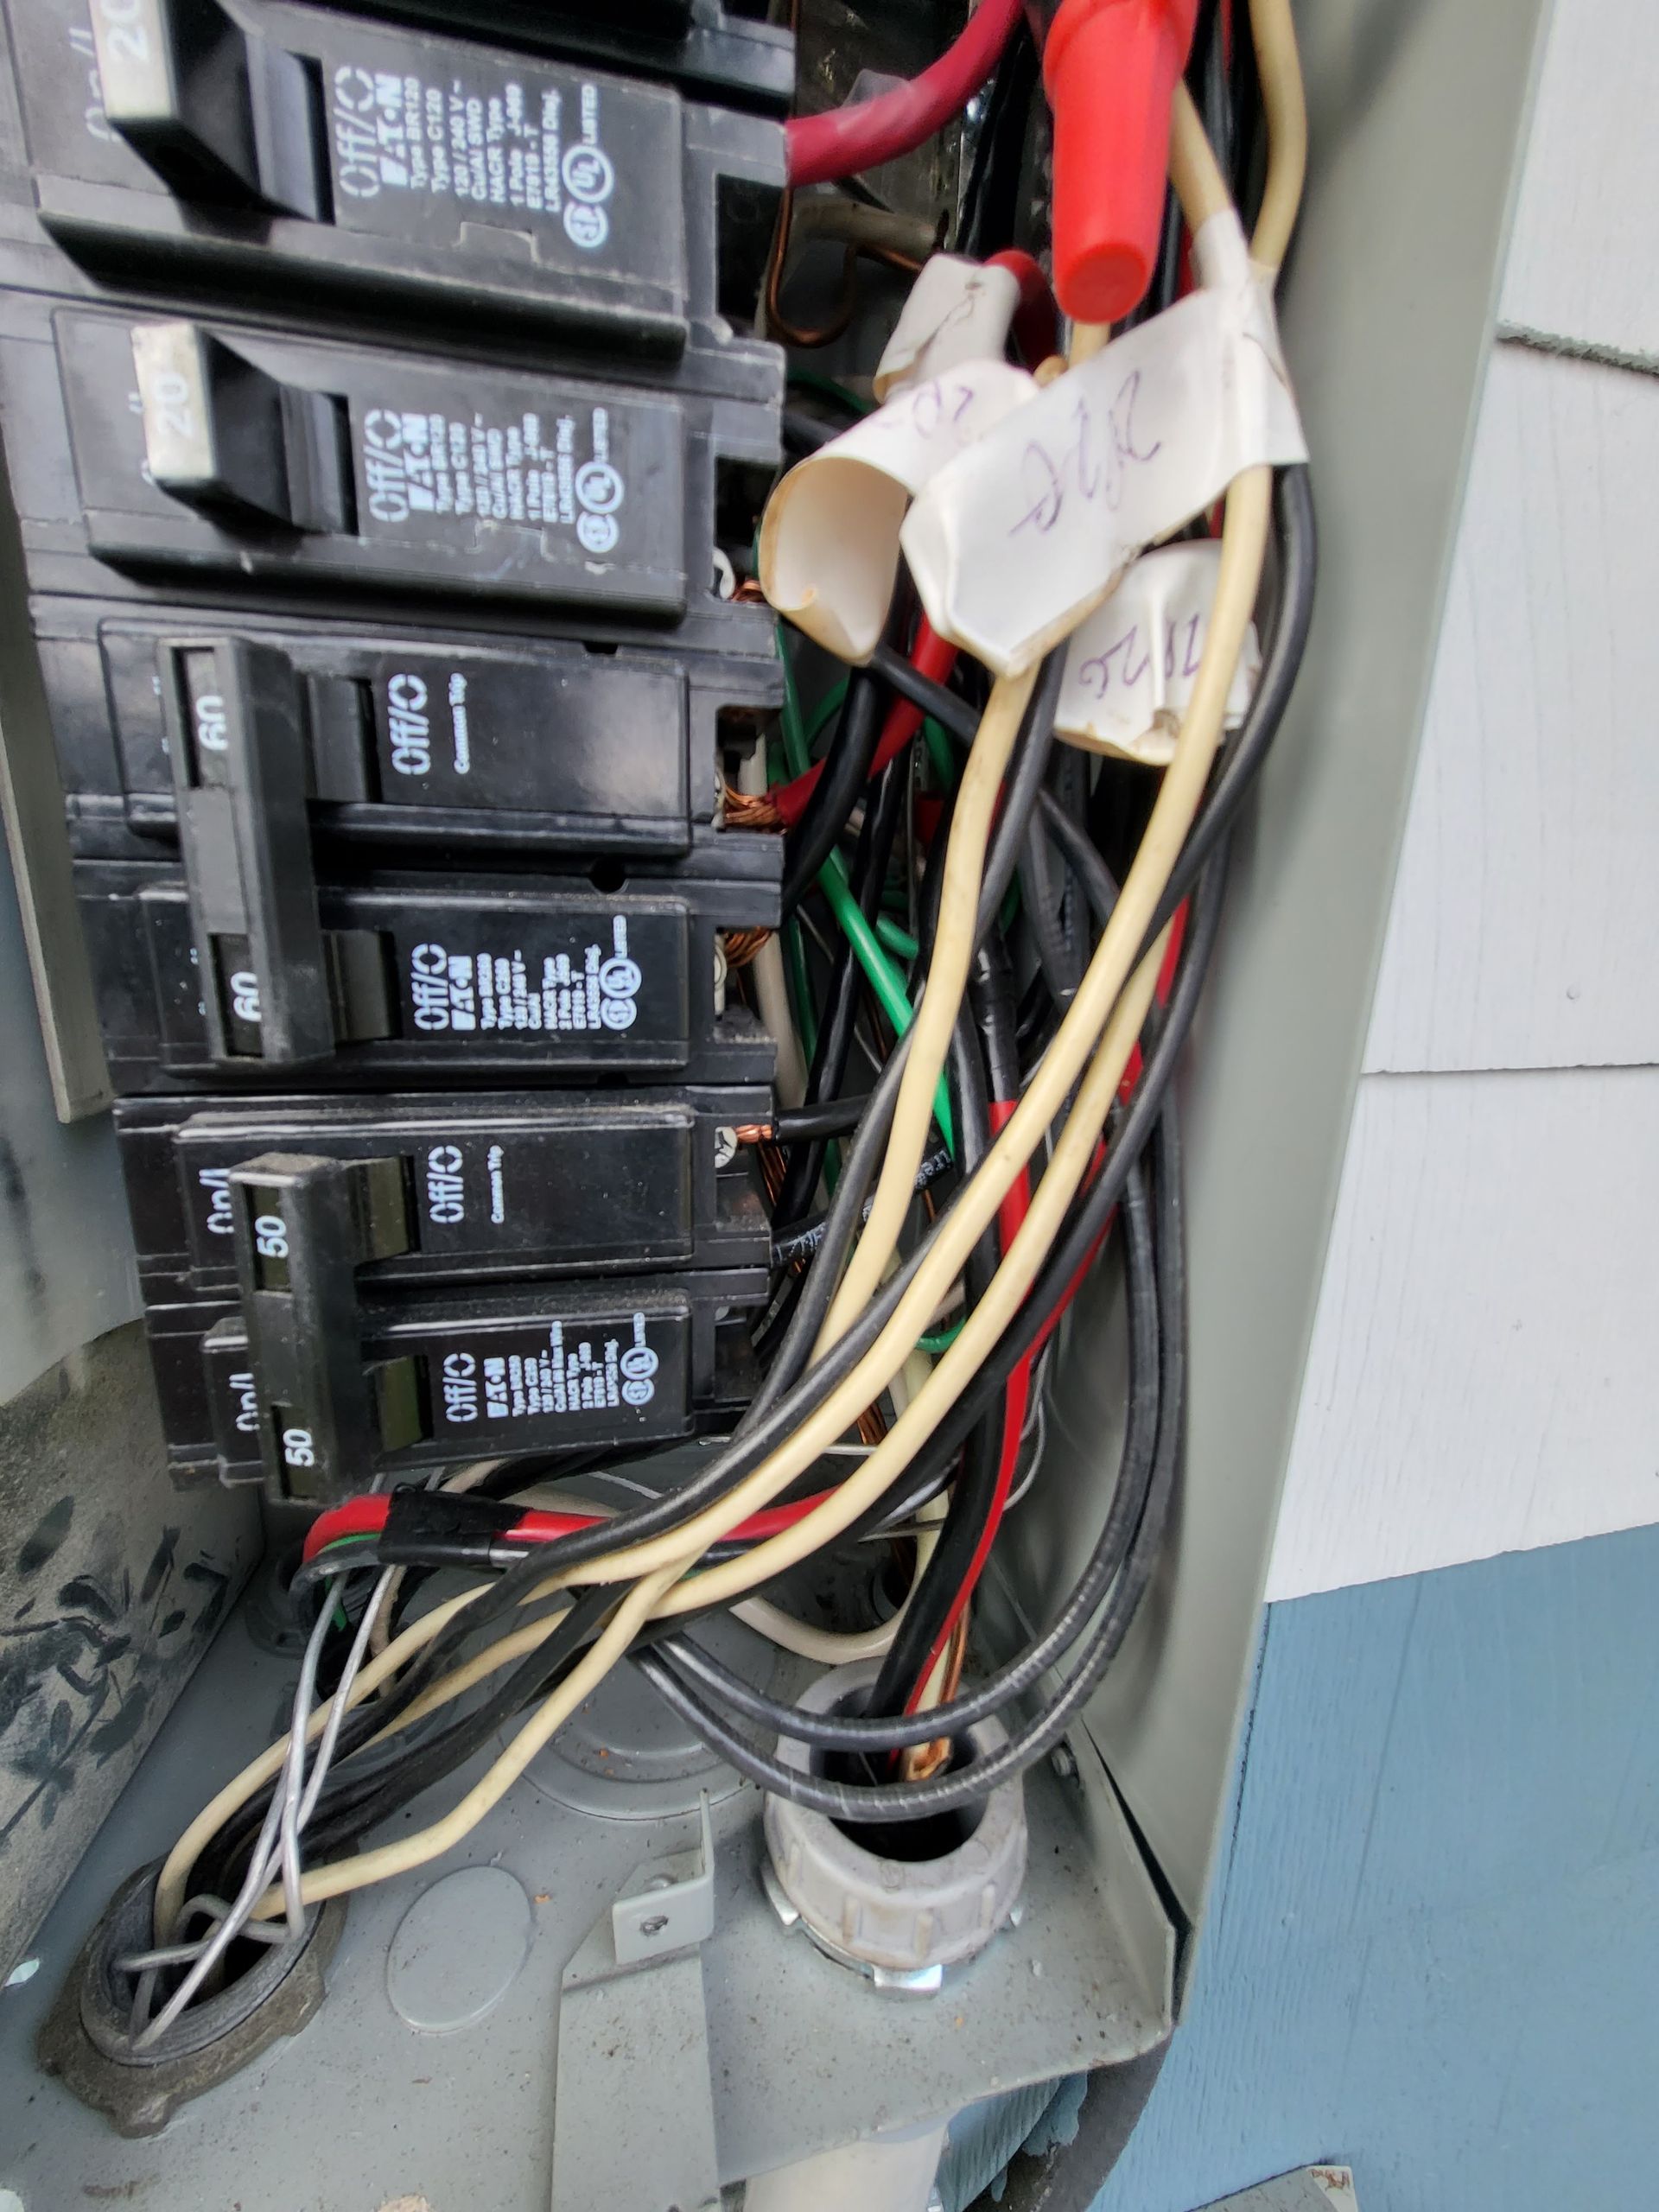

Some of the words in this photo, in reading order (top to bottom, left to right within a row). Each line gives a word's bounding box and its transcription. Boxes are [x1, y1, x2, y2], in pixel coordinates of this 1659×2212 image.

[404, 76, 422, 142] BR120
[425, 88, 444, 141] C120
[449, 115, 467, 150] 240
[466, 98, 484, 146] SWD
[486, 97, 505, 142] Type
[581, 84, 598, 145] LISTED
[410, 145, 429, 189] Type
[431, 146, 450, 193] Type
[453, 163, 470, 197] 120
[487, 146, 506, 203] HACR
[508, 148, 524, 190] Pole
[153, 372, 194, 438] 20
[387, 673, 430, 775] Off/O
[410, 944, 449, 1030] Off/O
[480, 997, 497, 1030] Type
[498, 995, 514, 1030] Type
[426, 1145, 465, 1224] Off/O
[254, 1215, 289, 1258] 50
[442, 1352, 478, 1422] Off/O
[283, 1428, 315, 1467] 50
